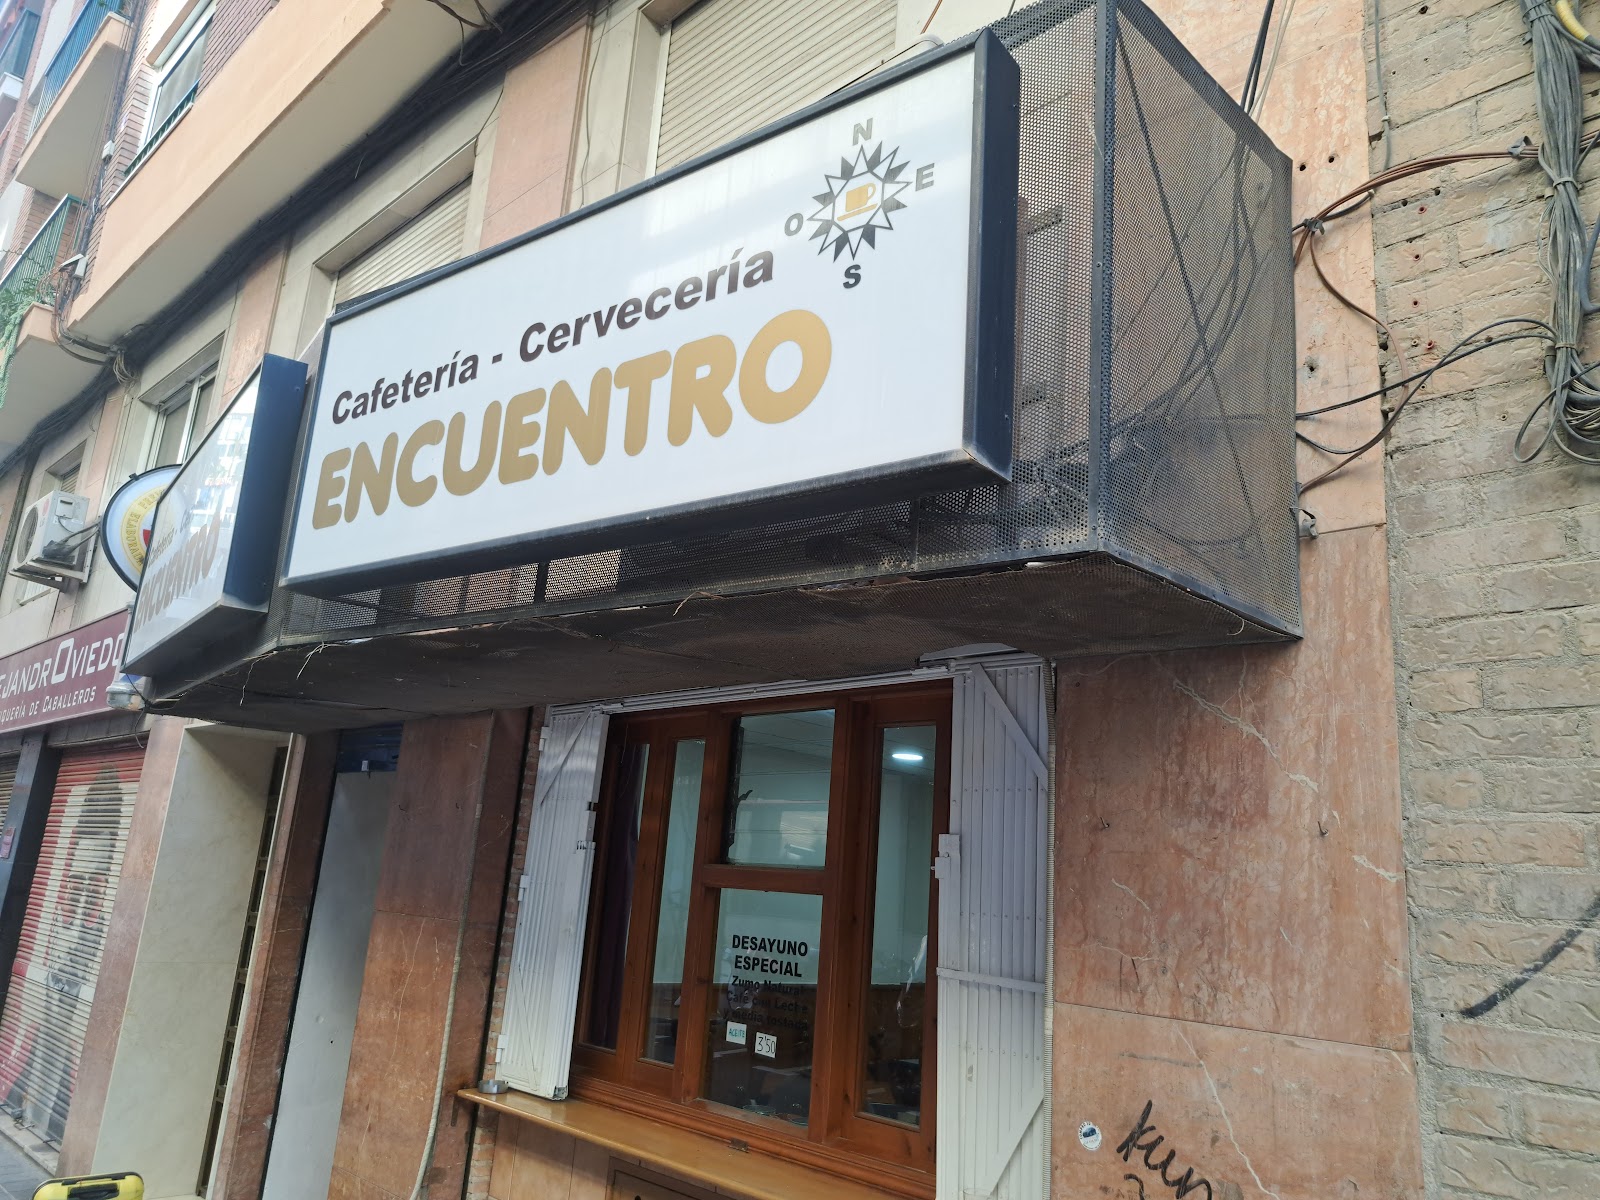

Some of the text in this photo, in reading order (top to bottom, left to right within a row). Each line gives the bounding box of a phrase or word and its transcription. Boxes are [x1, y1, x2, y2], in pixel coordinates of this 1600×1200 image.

[852, 117, 874, 146] N
[915, 162, 935, 192] E
[784, 212, 804, 237] O
[842, 264, 862, 290] S
[332, 247, 775, 425] Cafetería - Cervecería
[311, 309, 833, 530] ENCUENTRO
[133, 513, 221, 634] ENCUENTRO
[28, 701, 39, 716] DE
[42, 686, 97, 713] CABALLEROS
[732, 934, 808, 957] DESAYUNO
[734, 954, 803, 978] ESPECIAL
[731, 975, 760, 990] Zumo
